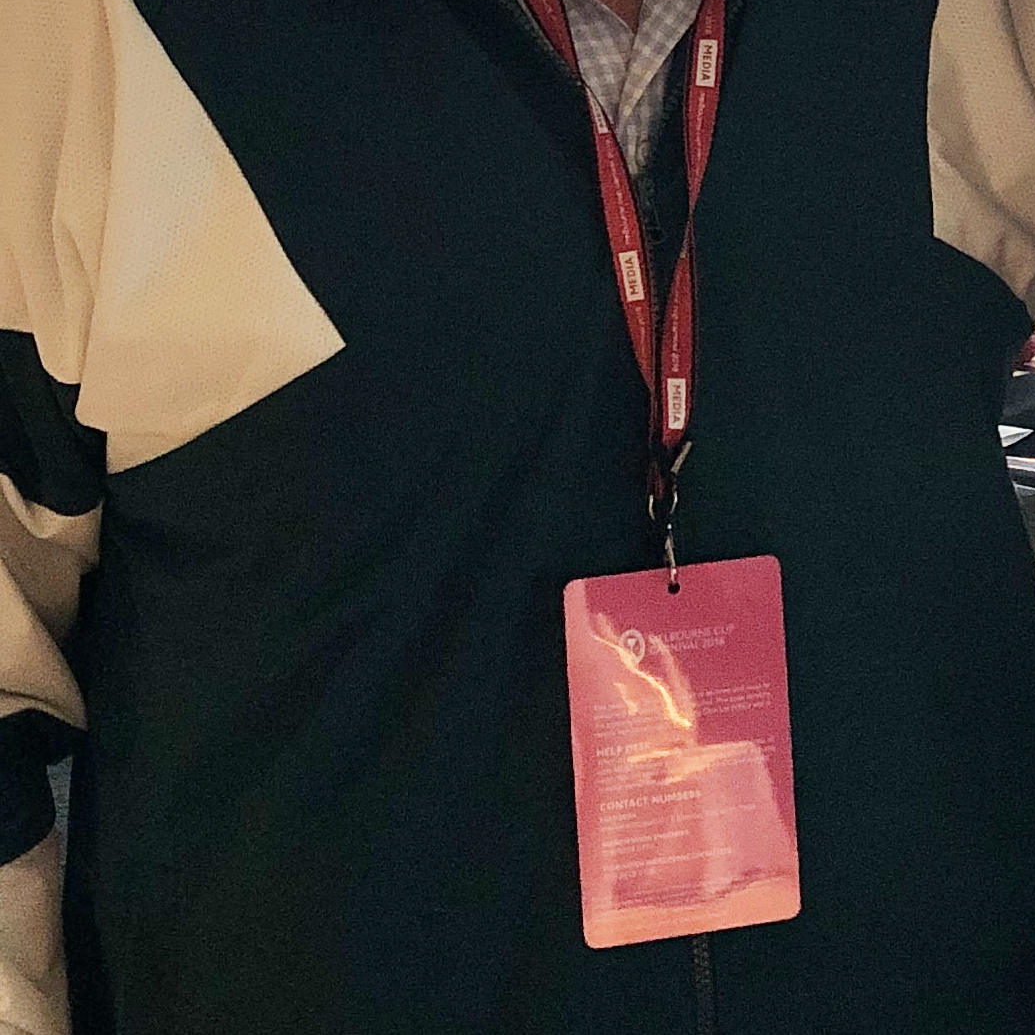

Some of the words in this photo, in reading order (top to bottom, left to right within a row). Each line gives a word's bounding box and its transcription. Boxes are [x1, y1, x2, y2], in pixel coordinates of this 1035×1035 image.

[701, 44, 713, 82] MEDIA
[624, 256, 639, 296] MEDIA
[672, 384, 682, 425] MEDIA
[596, 745, 624, 757] HELP
[600, 796, 648, 812] CONTACT
